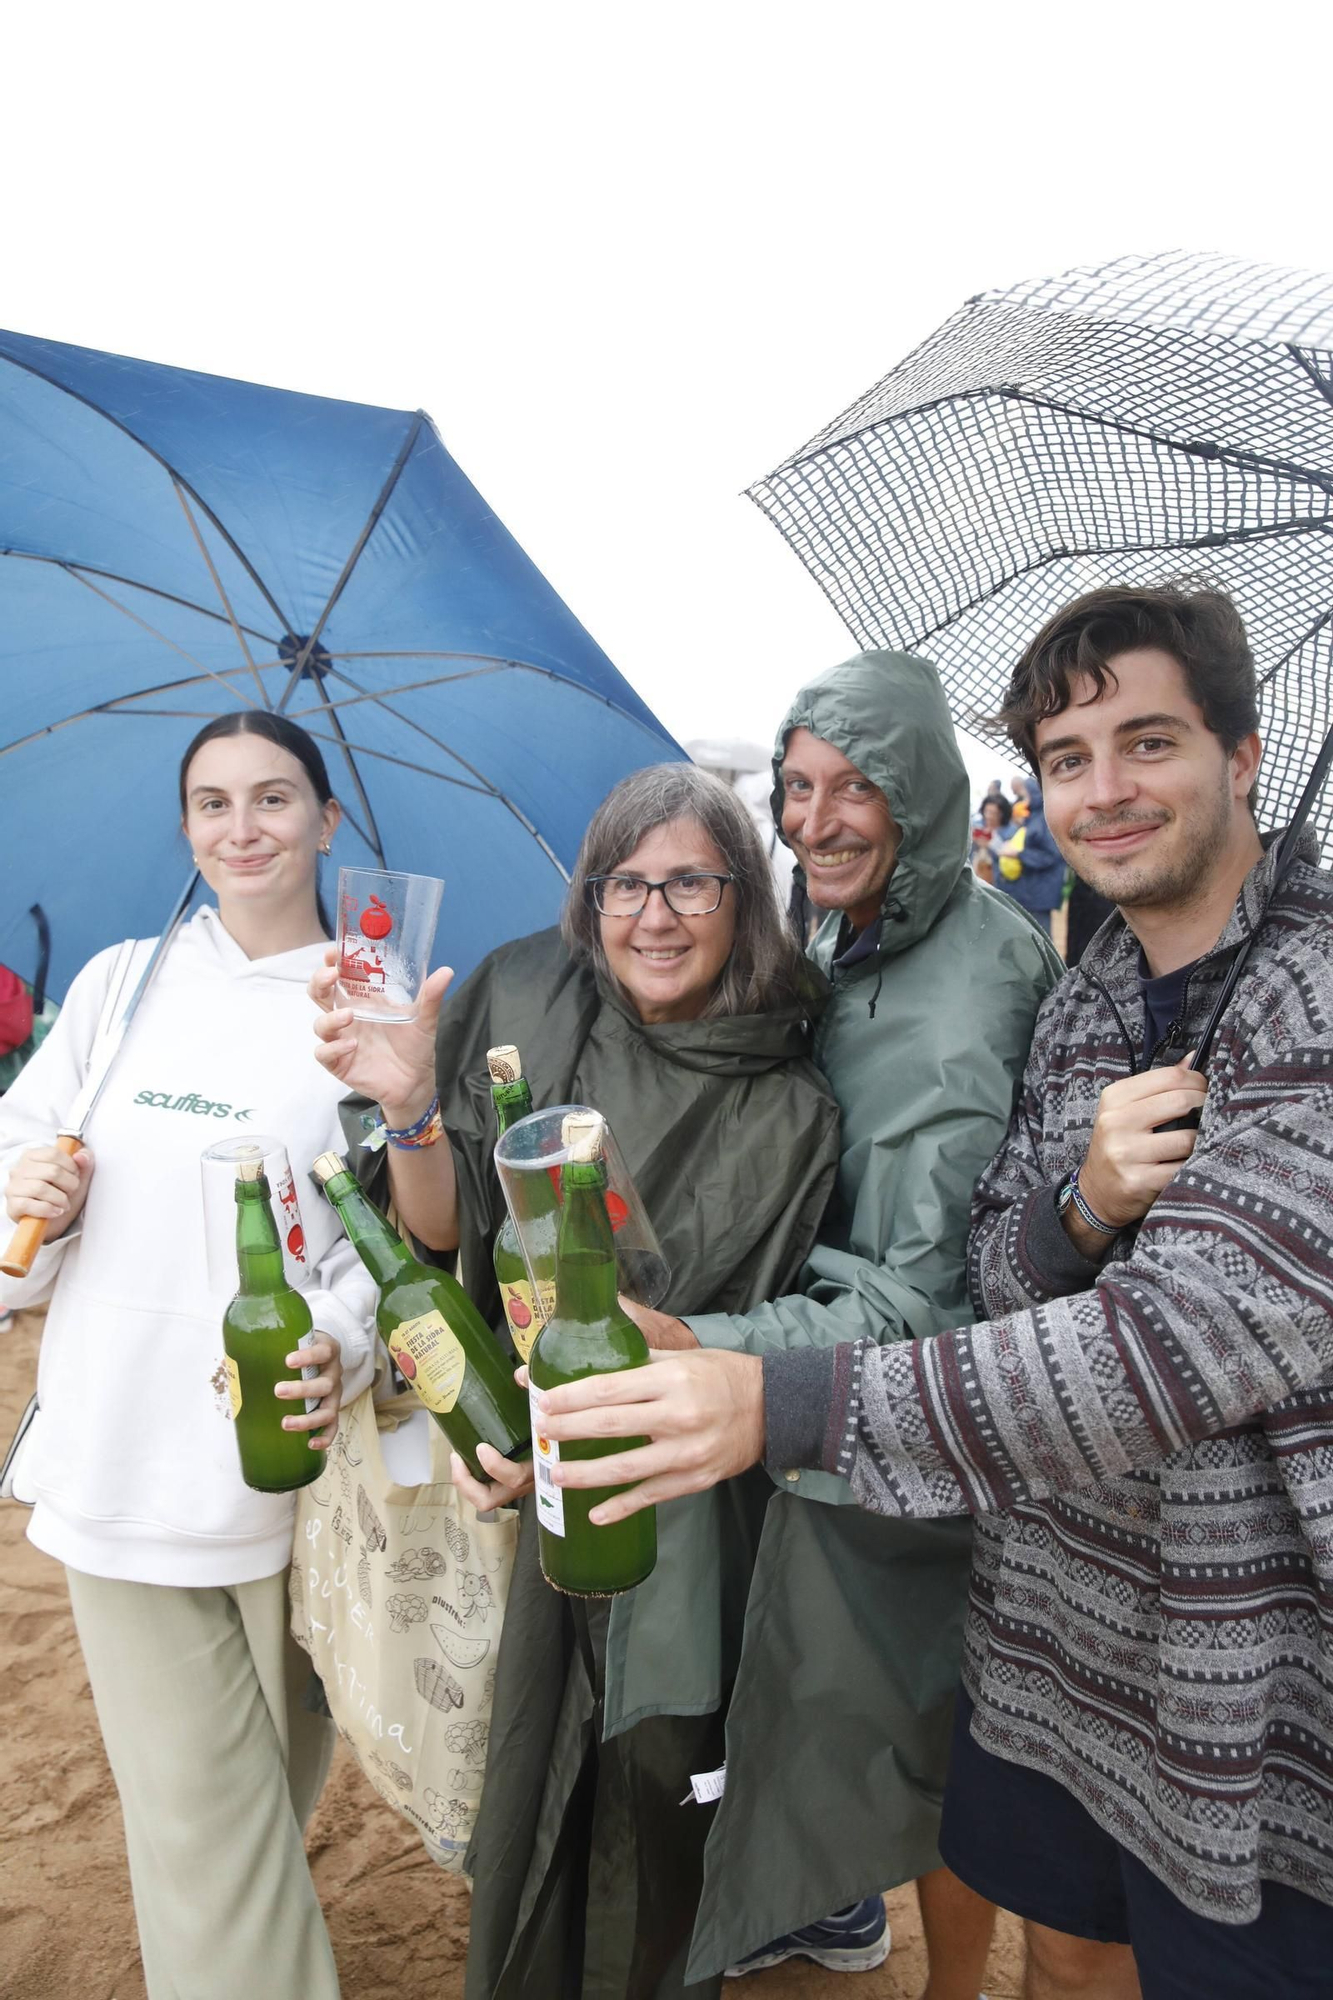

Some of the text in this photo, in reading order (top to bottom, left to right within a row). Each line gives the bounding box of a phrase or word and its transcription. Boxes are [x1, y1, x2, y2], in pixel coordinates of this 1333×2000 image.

[133, 1090, 233, 1119] scuffers
[406, 1332, 424, 1348] FIESTA
[410, 1343, 418, 1355] DE
[417, 1339, 426, 1349] LA
[425, 1326, 445, 1342] SIDRA
[414, 1339, 440, 1360] NATURAL
